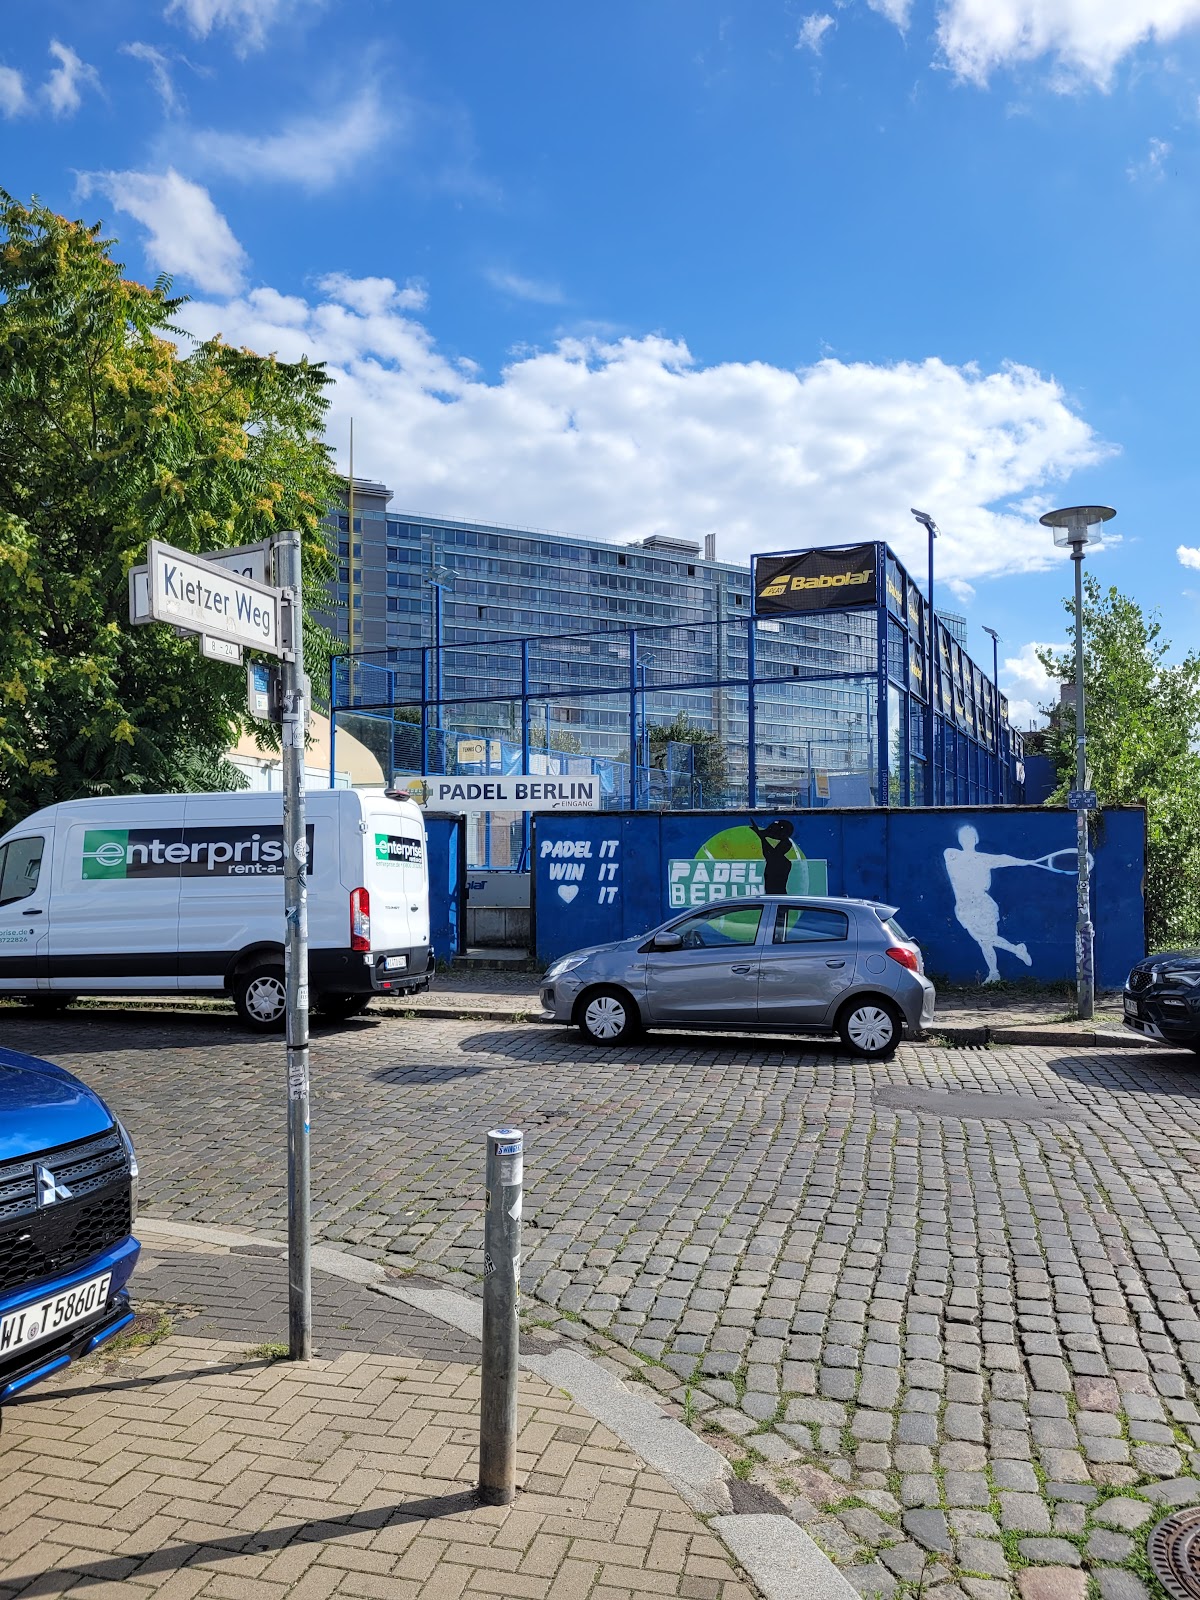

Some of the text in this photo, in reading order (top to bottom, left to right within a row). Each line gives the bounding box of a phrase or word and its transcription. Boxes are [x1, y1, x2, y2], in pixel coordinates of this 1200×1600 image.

[164, 563, 270, 638] Kietzer Weg
[211, 640, 216, 651] 8
[224, 644, 233, 656] 24
[439, 782, 593, 800] PADEL BERLIN
[561, 800, 593, 808] EINGANG
[376, 839, 422, 860] enterprise
[540, 840, 620, 859] PADEL IT
[549, 863, 619, 881] WIN IT
[671, 862, 763, 883] PADEL
[598, 887, 619, 905] IT
[0, 1313, 27, 1351] WI
